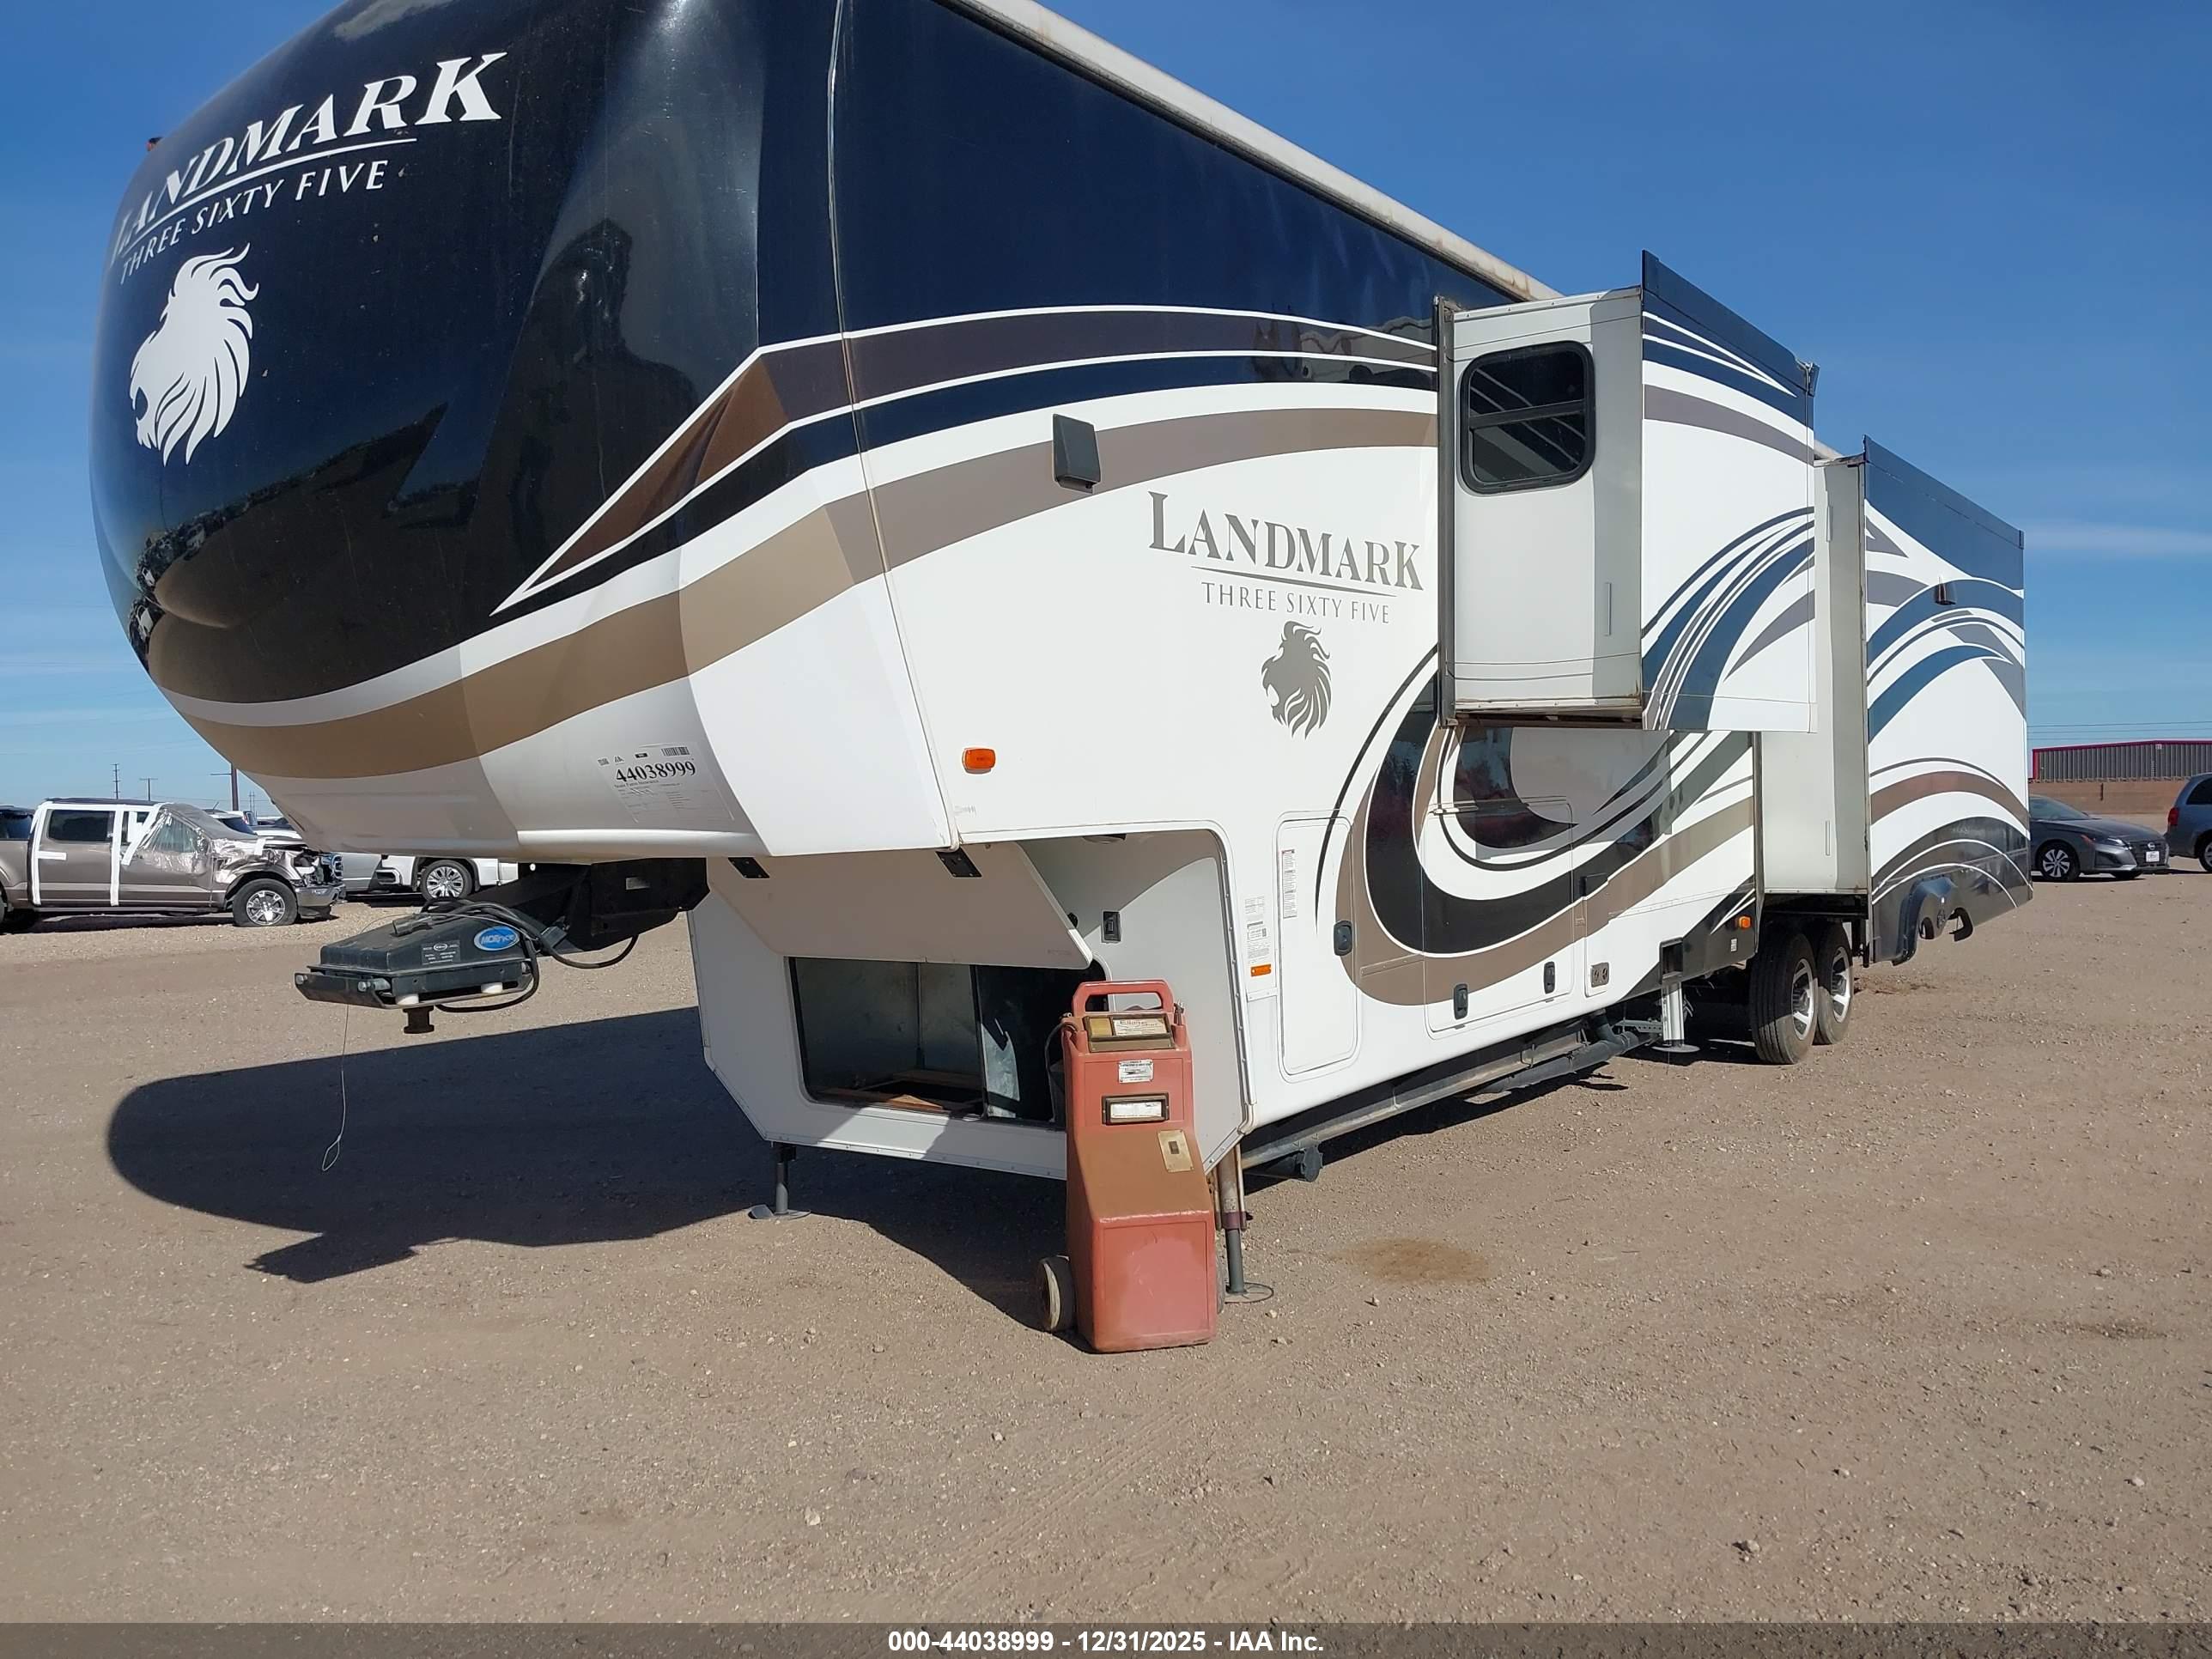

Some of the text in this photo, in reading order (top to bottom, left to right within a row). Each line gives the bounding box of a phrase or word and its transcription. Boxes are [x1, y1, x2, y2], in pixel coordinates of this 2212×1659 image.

[110, 52, 507, 267] LANDMARK
[120, 160, 389, 285] THREE SIXTY FIVE
[1147, 490, 1425, 591] LANDMARK
[1201, 581, 1389, 624] THREE SIXTY FIVE
[616, 761, 696, 782] 44038999
